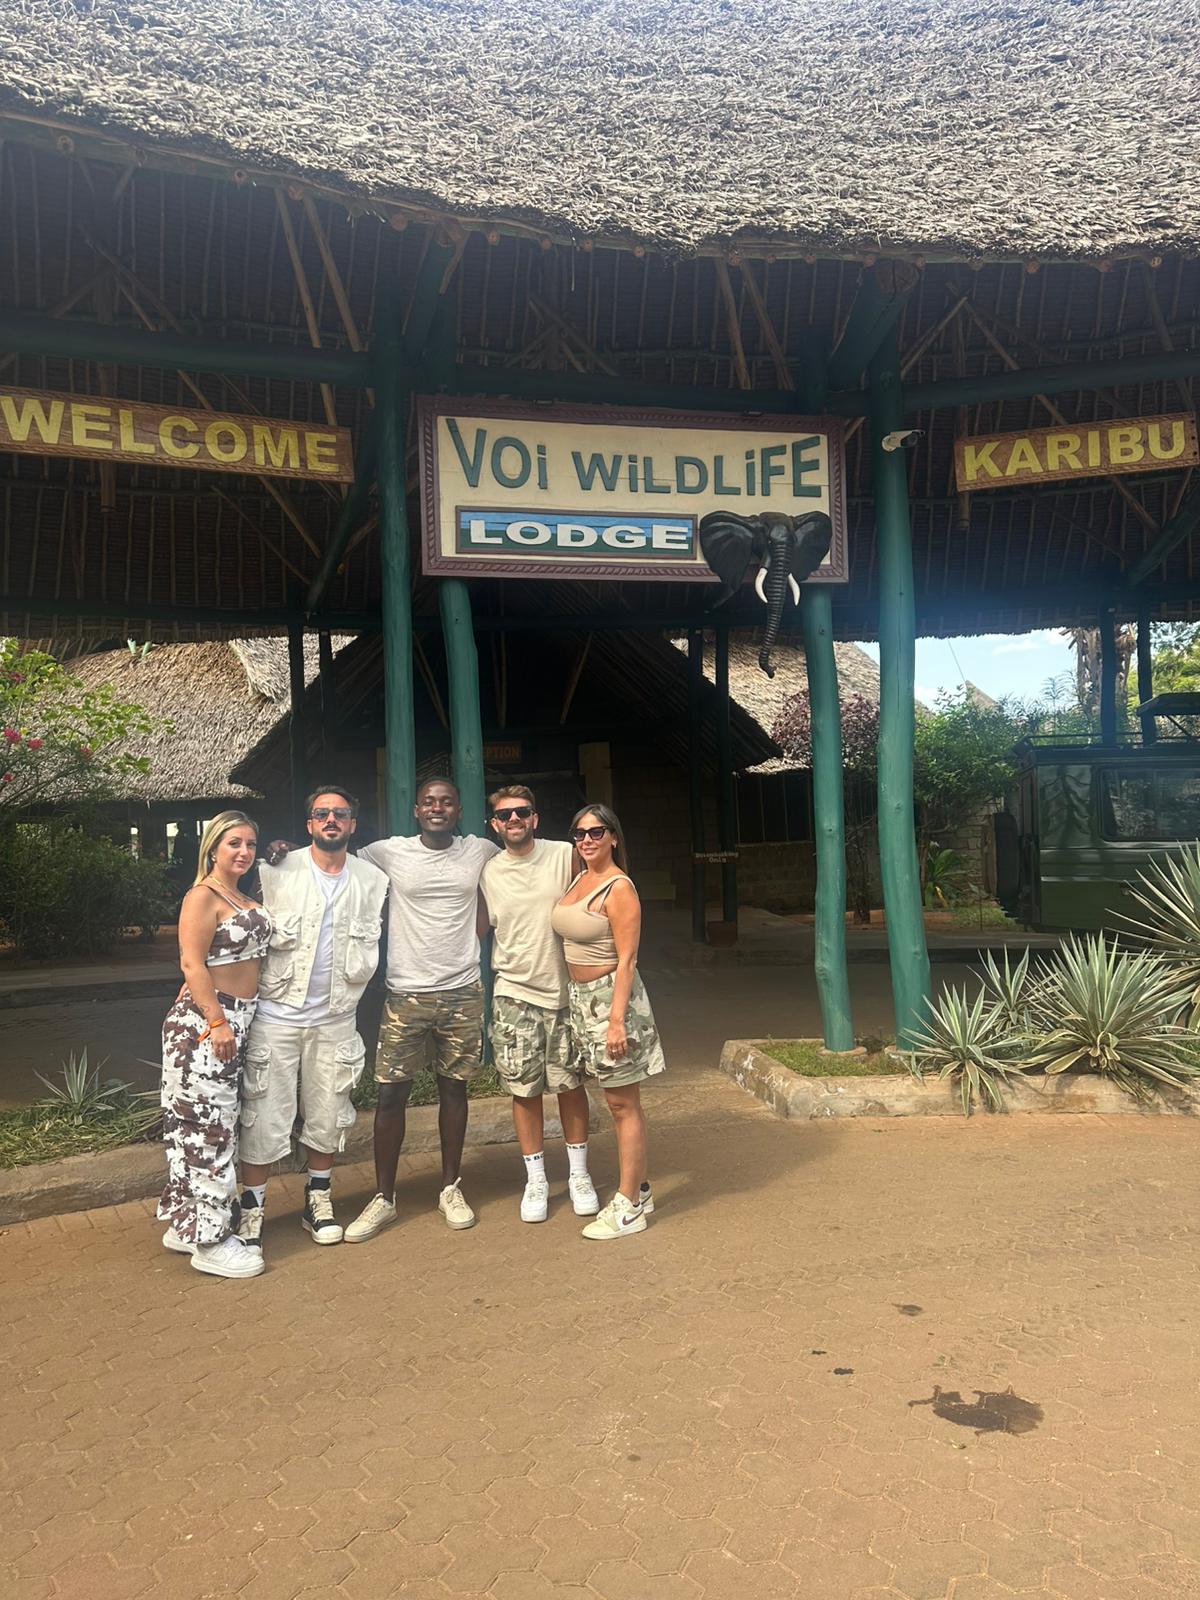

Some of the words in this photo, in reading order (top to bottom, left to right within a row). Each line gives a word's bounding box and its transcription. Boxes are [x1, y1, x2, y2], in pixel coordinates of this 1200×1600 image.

[0, 396, 339, 472] WELCOME
[964, 420, 1186, 481] KARIBU
[469, 519, 690, 550] LODGE
